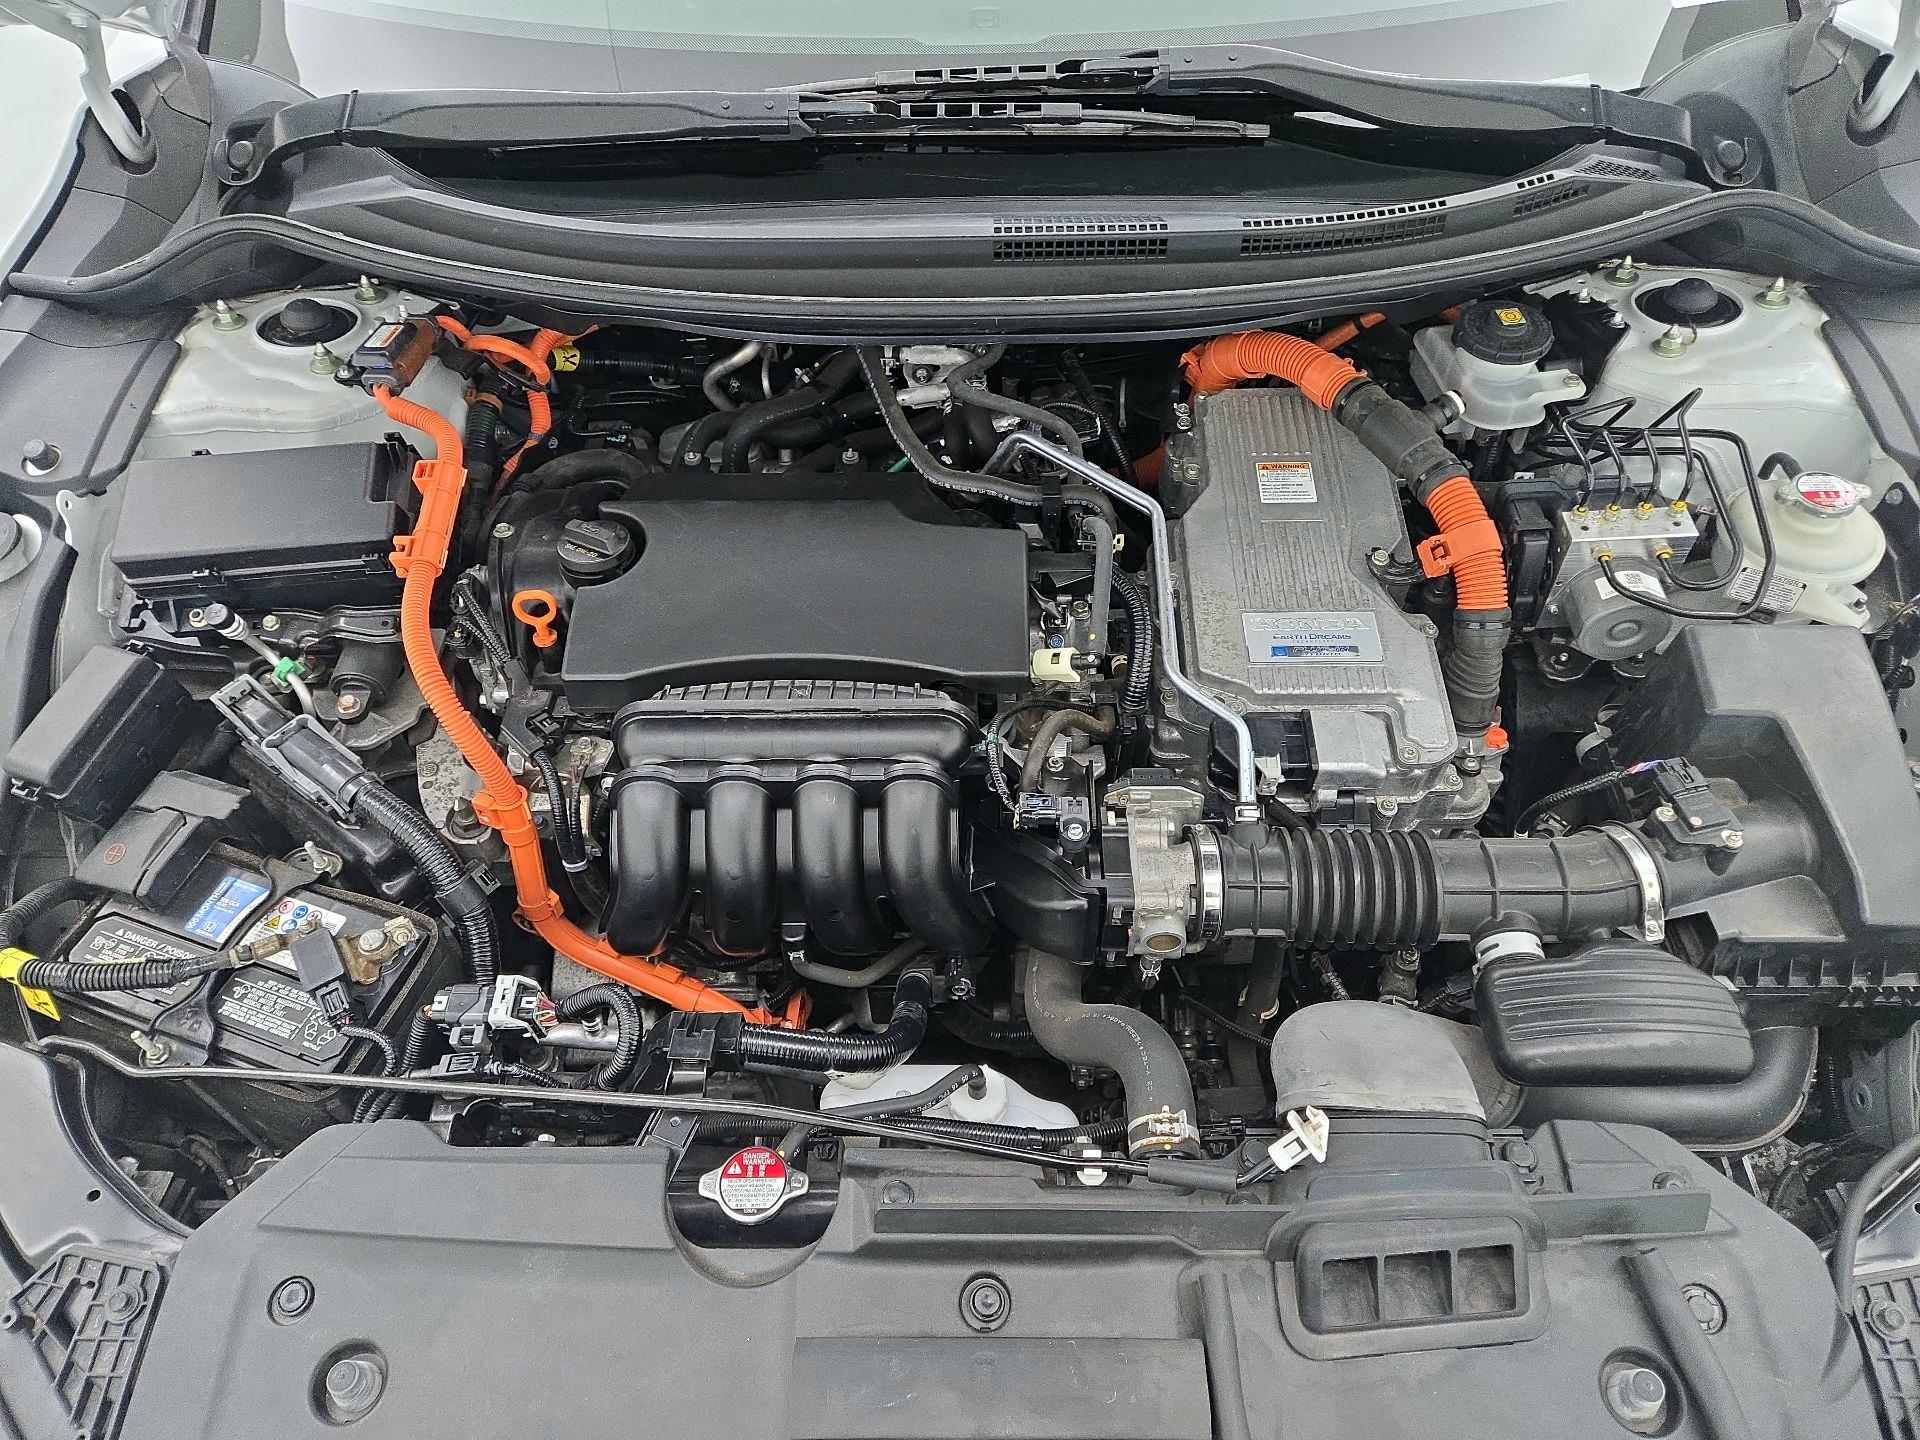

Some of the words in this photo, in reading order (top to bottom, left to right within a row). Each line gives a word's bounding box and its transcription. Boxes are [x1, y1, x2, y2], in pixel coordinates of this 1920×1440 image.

[1249, 617, 1370, 631] HONDA
[199, 890, 222, 918] MONTH
[124, 931, 158, 947] DANGER
